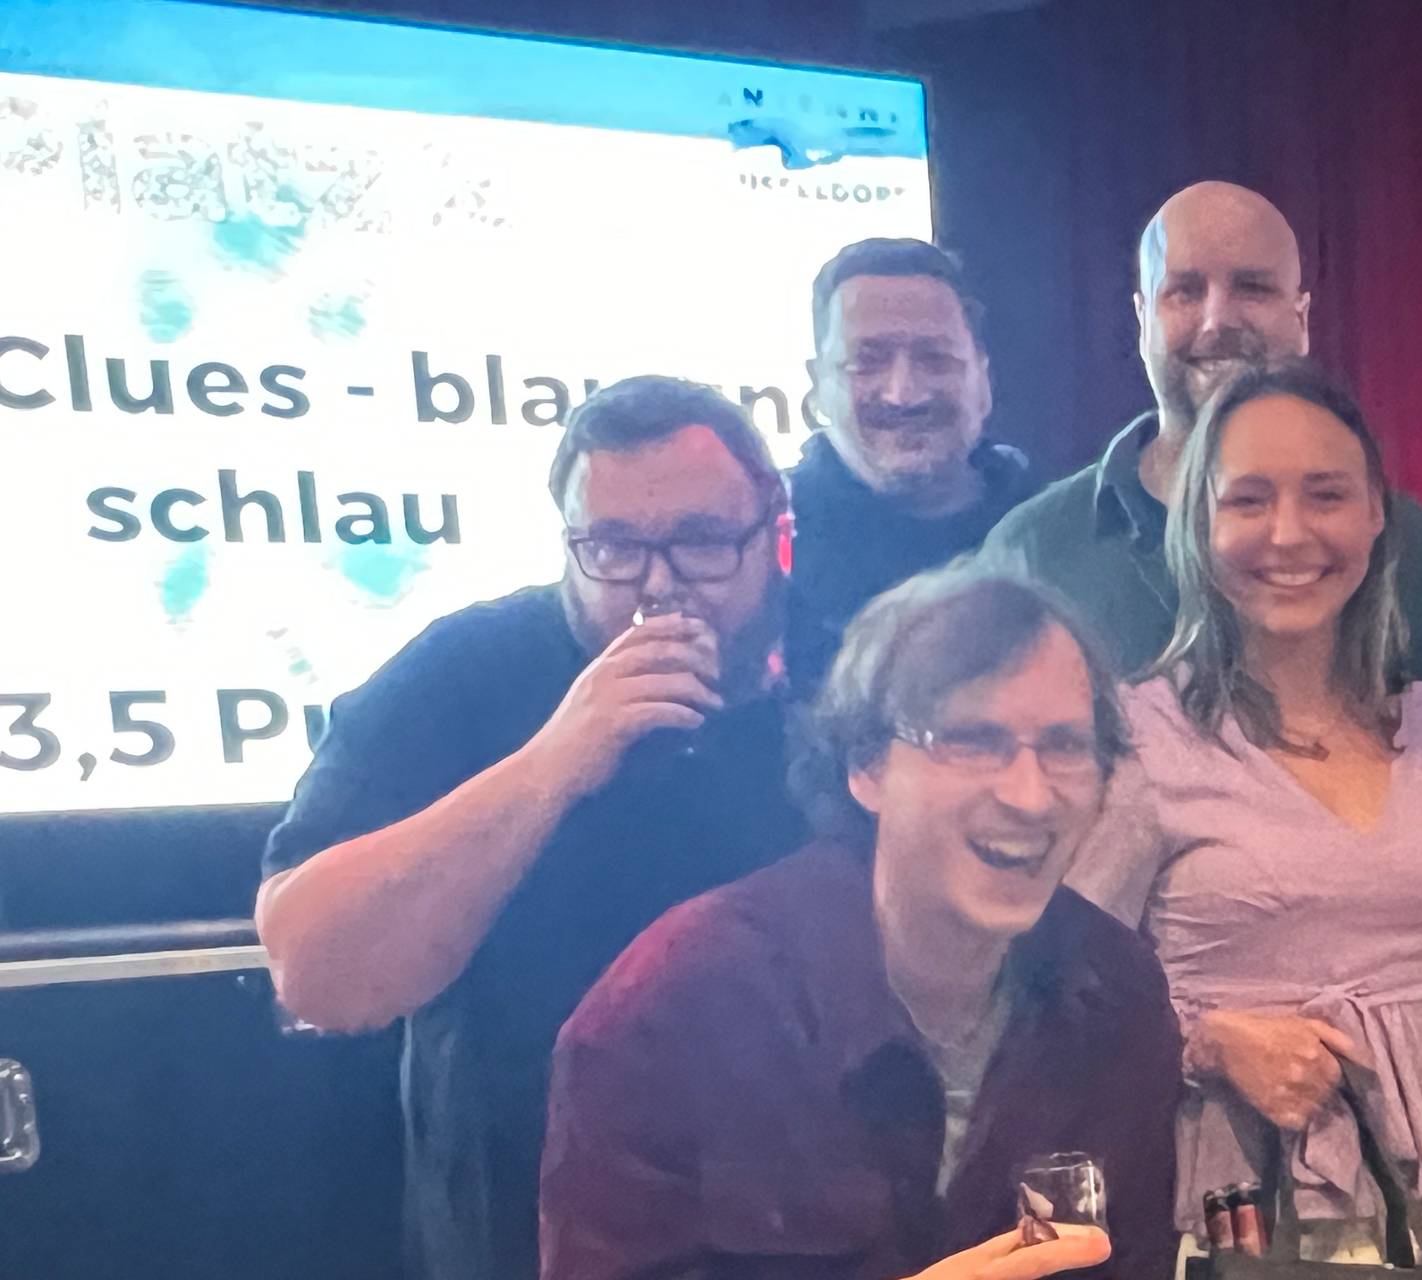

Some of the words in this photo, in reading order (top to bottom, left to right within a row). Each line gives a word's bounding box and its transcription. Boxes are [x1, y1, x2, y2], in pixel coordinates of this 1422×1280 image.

[0, 334, 310, 419] Clues
[347, 386, 374, 396] -
[411, 350, 598, 425] bla
[87, 469, 461, 544] schlau
